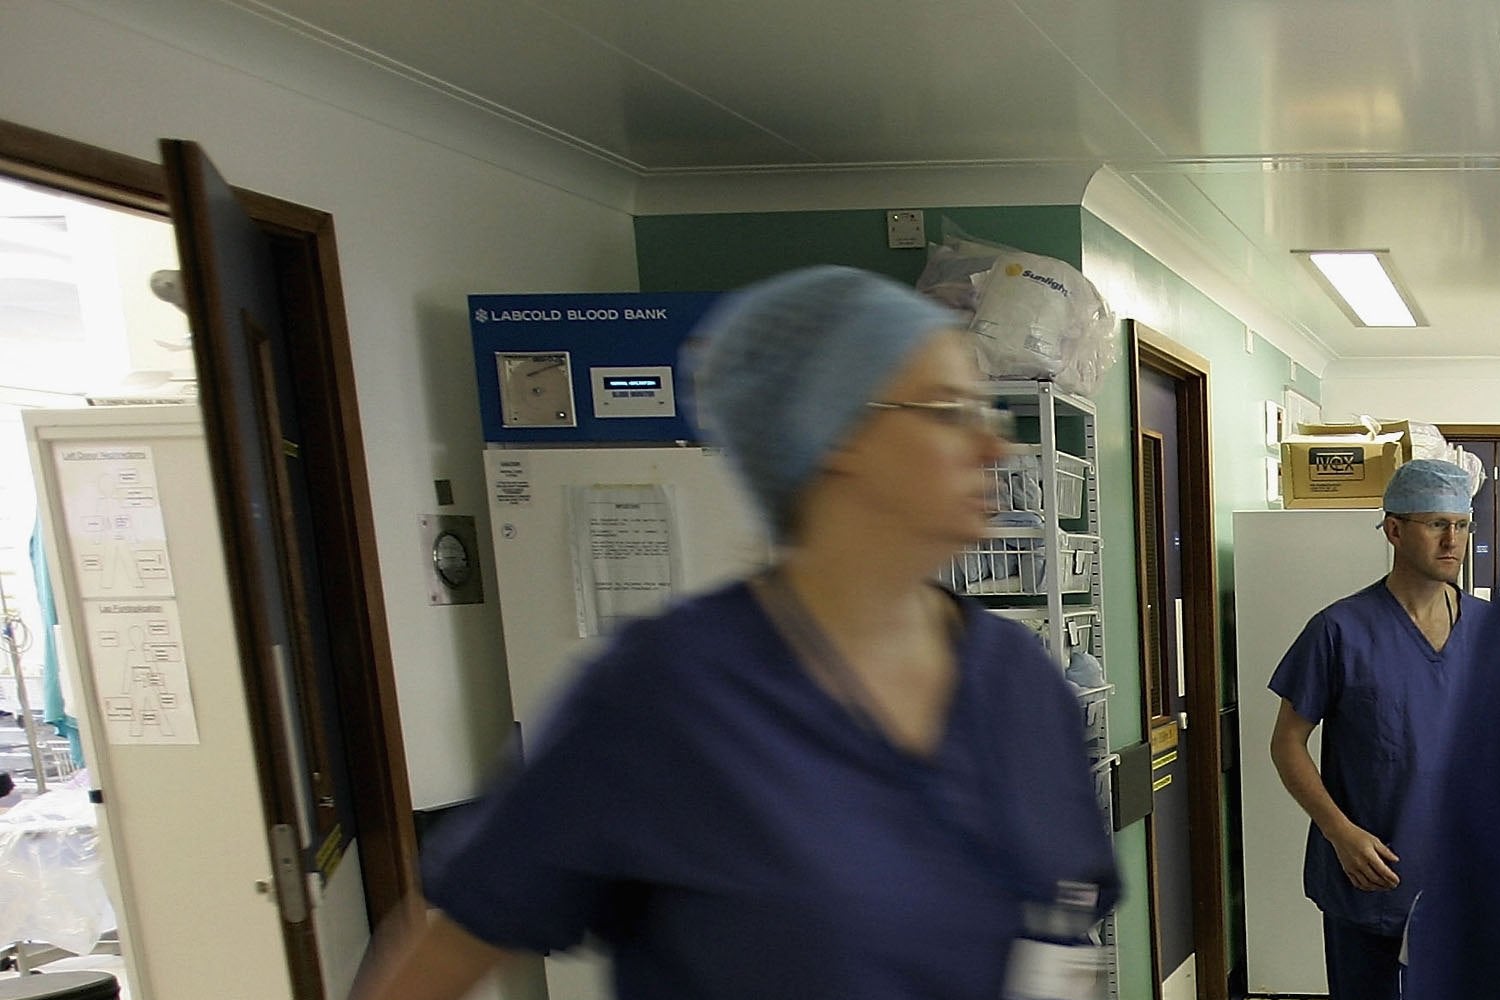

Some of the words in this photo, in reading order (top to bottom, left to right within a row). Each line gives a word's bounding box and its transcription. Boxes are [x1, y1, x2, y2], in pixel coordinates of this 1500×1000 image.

[1022, 270, 1069, 297] Sunligh
[491, 310, 562, 322] LABCOLD
[567, 309, 619, 321] BLOOD
[624, 308, 668, 320] BANK
